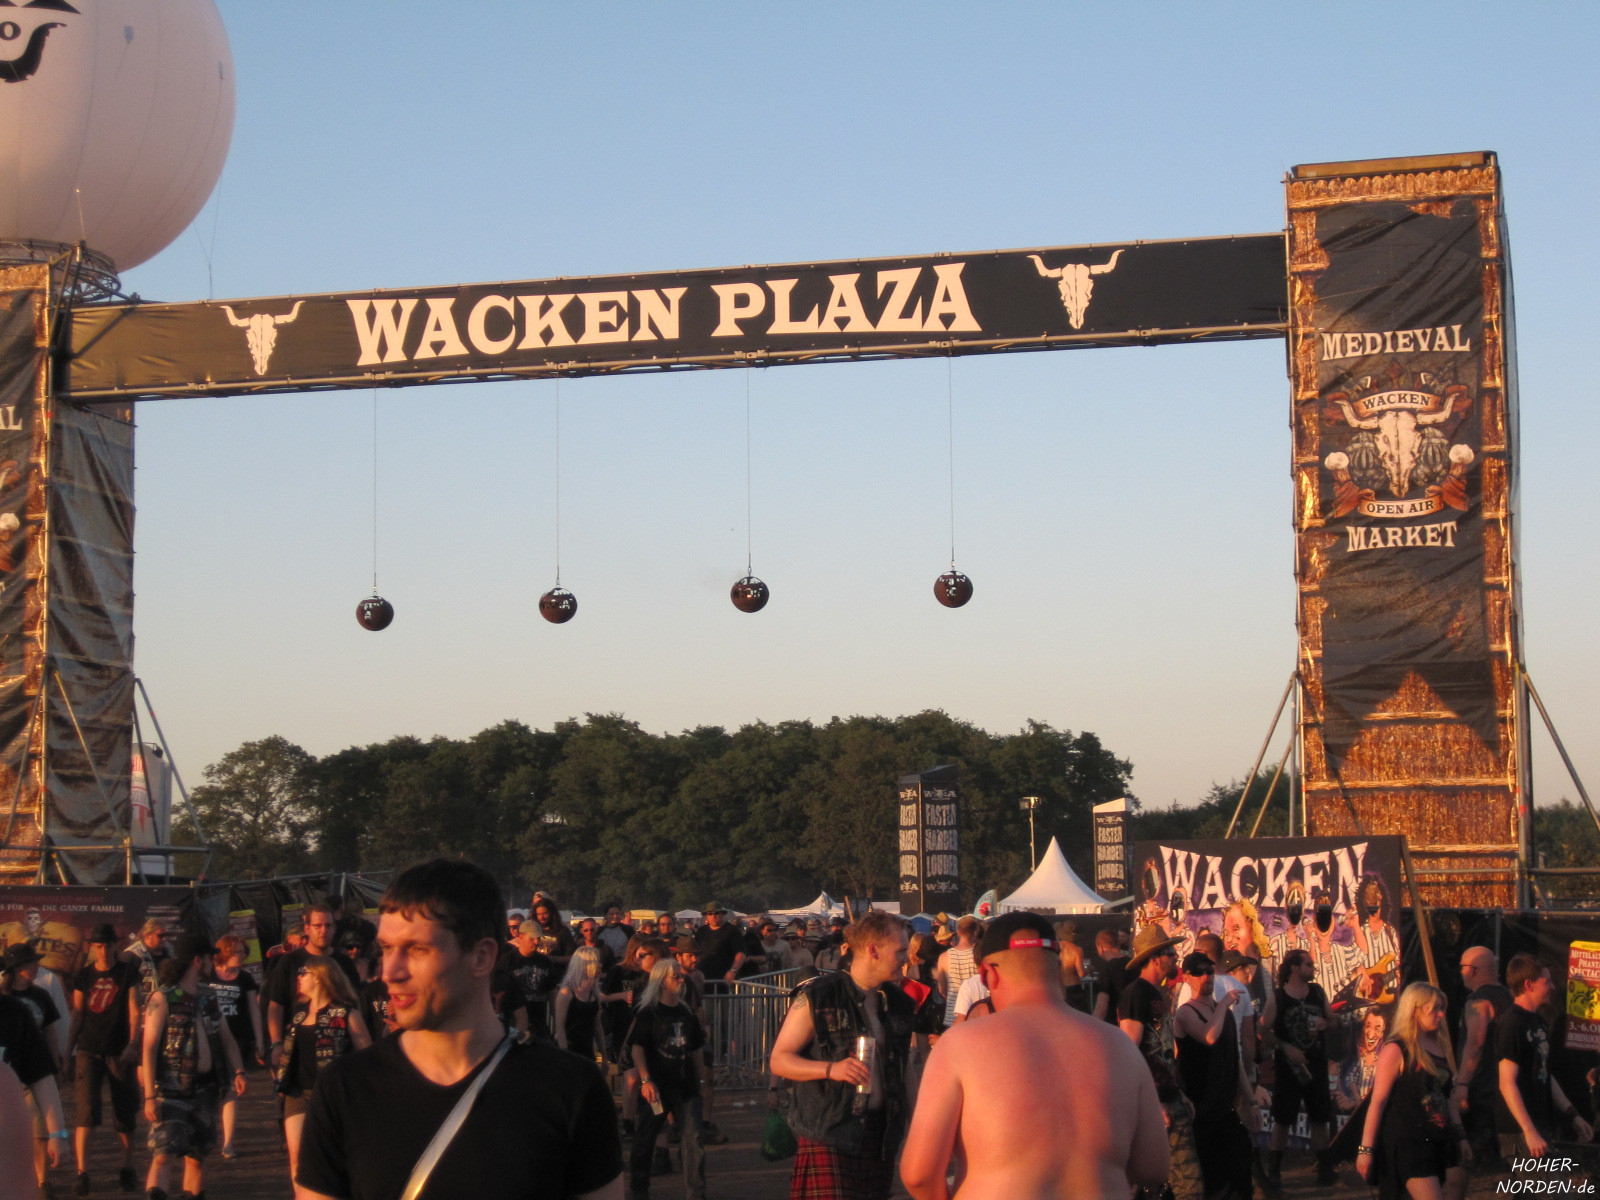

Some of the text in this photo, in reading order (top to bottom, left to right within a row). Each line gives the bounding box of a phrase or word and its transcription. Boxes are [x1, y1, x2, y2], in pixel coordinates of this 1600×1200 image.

[346, 262, 983, 366] WACKEN PLAZA
[1320, 324, 1471, 361] MEDIEVAL
[1362, 393, 1431, 410] WACKEN
[1366, 500, 1435, 514] OPEN AIR
[1345, 521, 1458, 552] MARKET
[1159, 842, 1369, 914] WACKEN
[42, 904, 57, 912] DIE
[60, 904, 89, 912] GANZE
